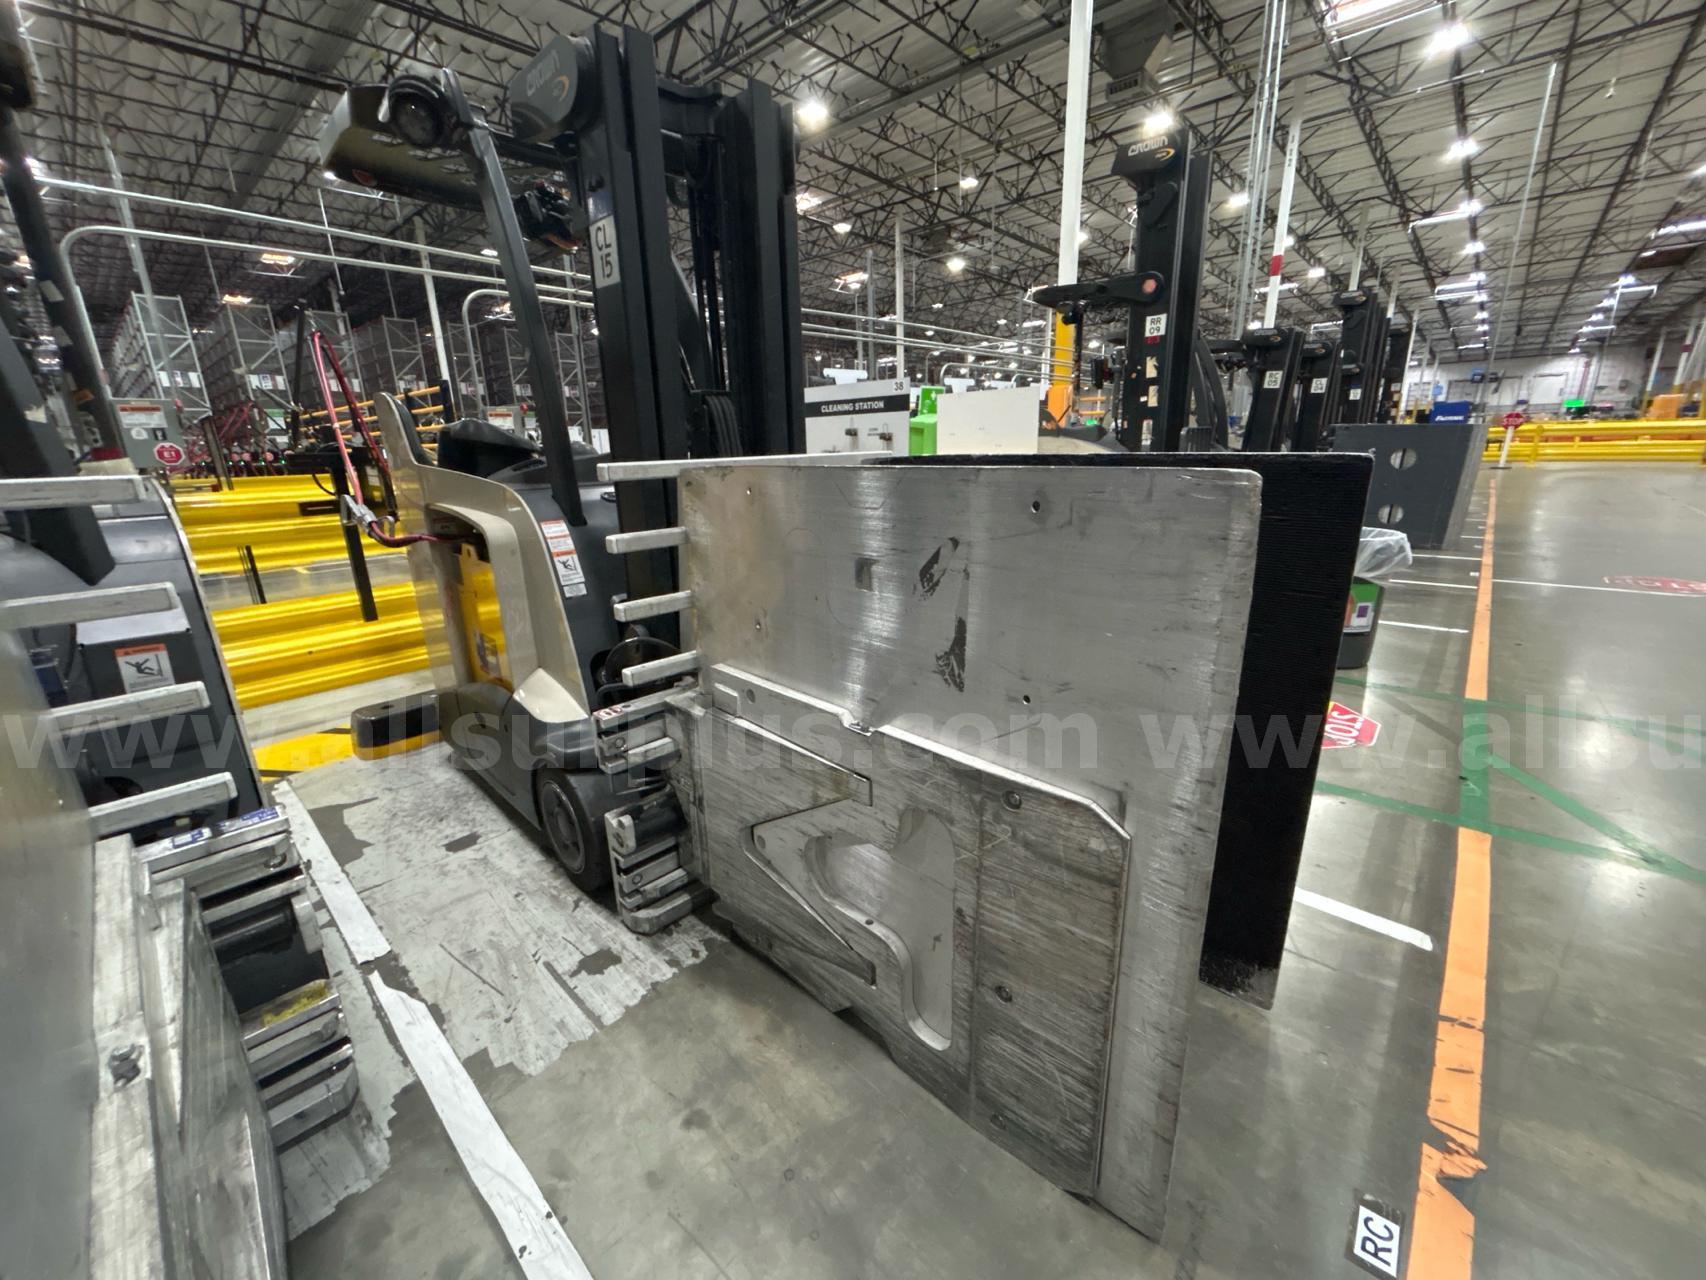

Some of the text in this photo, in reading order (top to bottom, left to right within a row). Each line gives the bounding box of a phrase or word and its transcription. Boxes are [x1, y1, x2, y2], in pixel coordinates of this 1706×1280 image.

[595, 224, 612, 251] CL
[601, 253, 613, 279] 15
[1149, 326, 1161, 335] 09
[1150, 316, 1162, 326] RR
[821, 400, 884, 413] CLEANING STATION
[1361, 1216, 1394, 1267] RC
